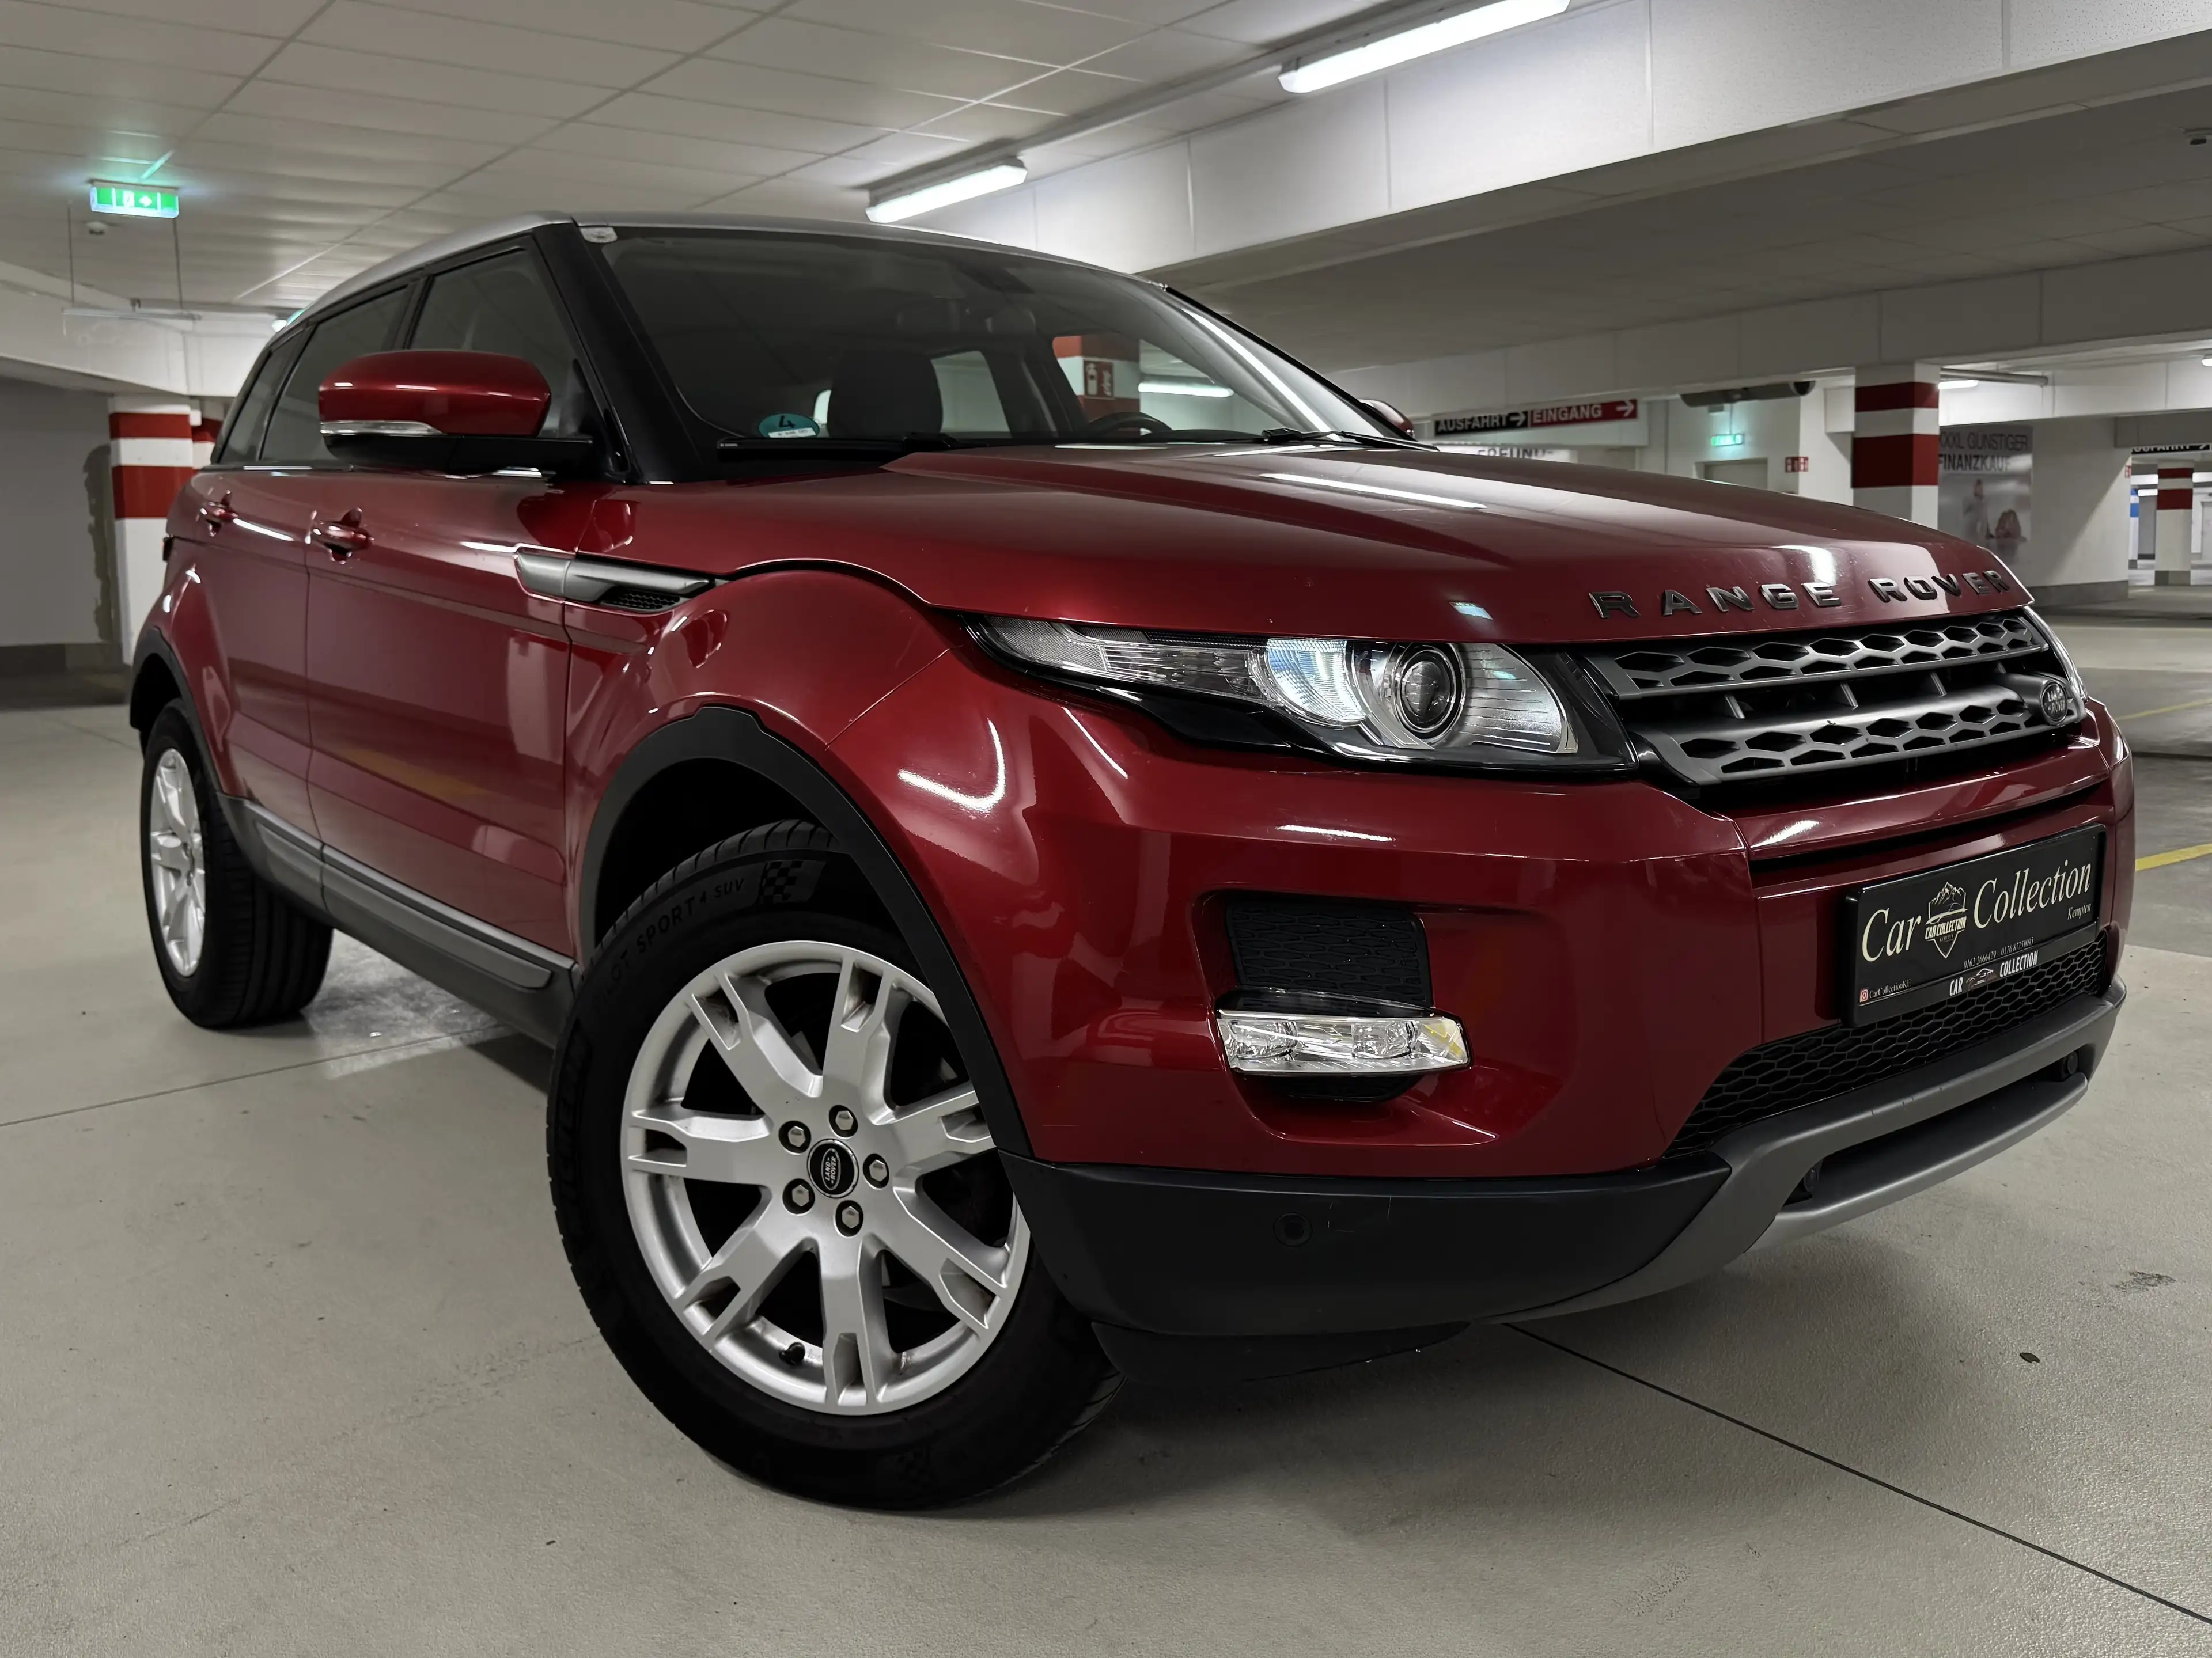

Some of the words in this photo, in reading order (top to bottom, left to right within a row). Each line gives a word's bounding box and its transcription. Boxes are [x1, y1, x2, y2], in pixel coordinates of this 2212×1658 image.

[779, 415, 796, 428] 4
[1437, 413, 1509, 432] AUSFAHRT
[1532, 404, 1603, 424] EINGANG
[1588, 582, 1842, 619] RANGE
[1868, 570, 2010, 603] ROVER
[637, 896, 700, 954] SPORT
[714, 878, 745, 898] SUV
[1862, 908, 1921, 962] Car
[1974, 859, 2091, 928] Collection
[2067, 903, 2092, 920] Kempten
[1925, 925, 1937, 940] CAR
[1936, 916, 1967, 936] COLLECTION
[1949, 977, 1963, 996] CAR
[1999, 950, 2039, 978] COLLECTION
